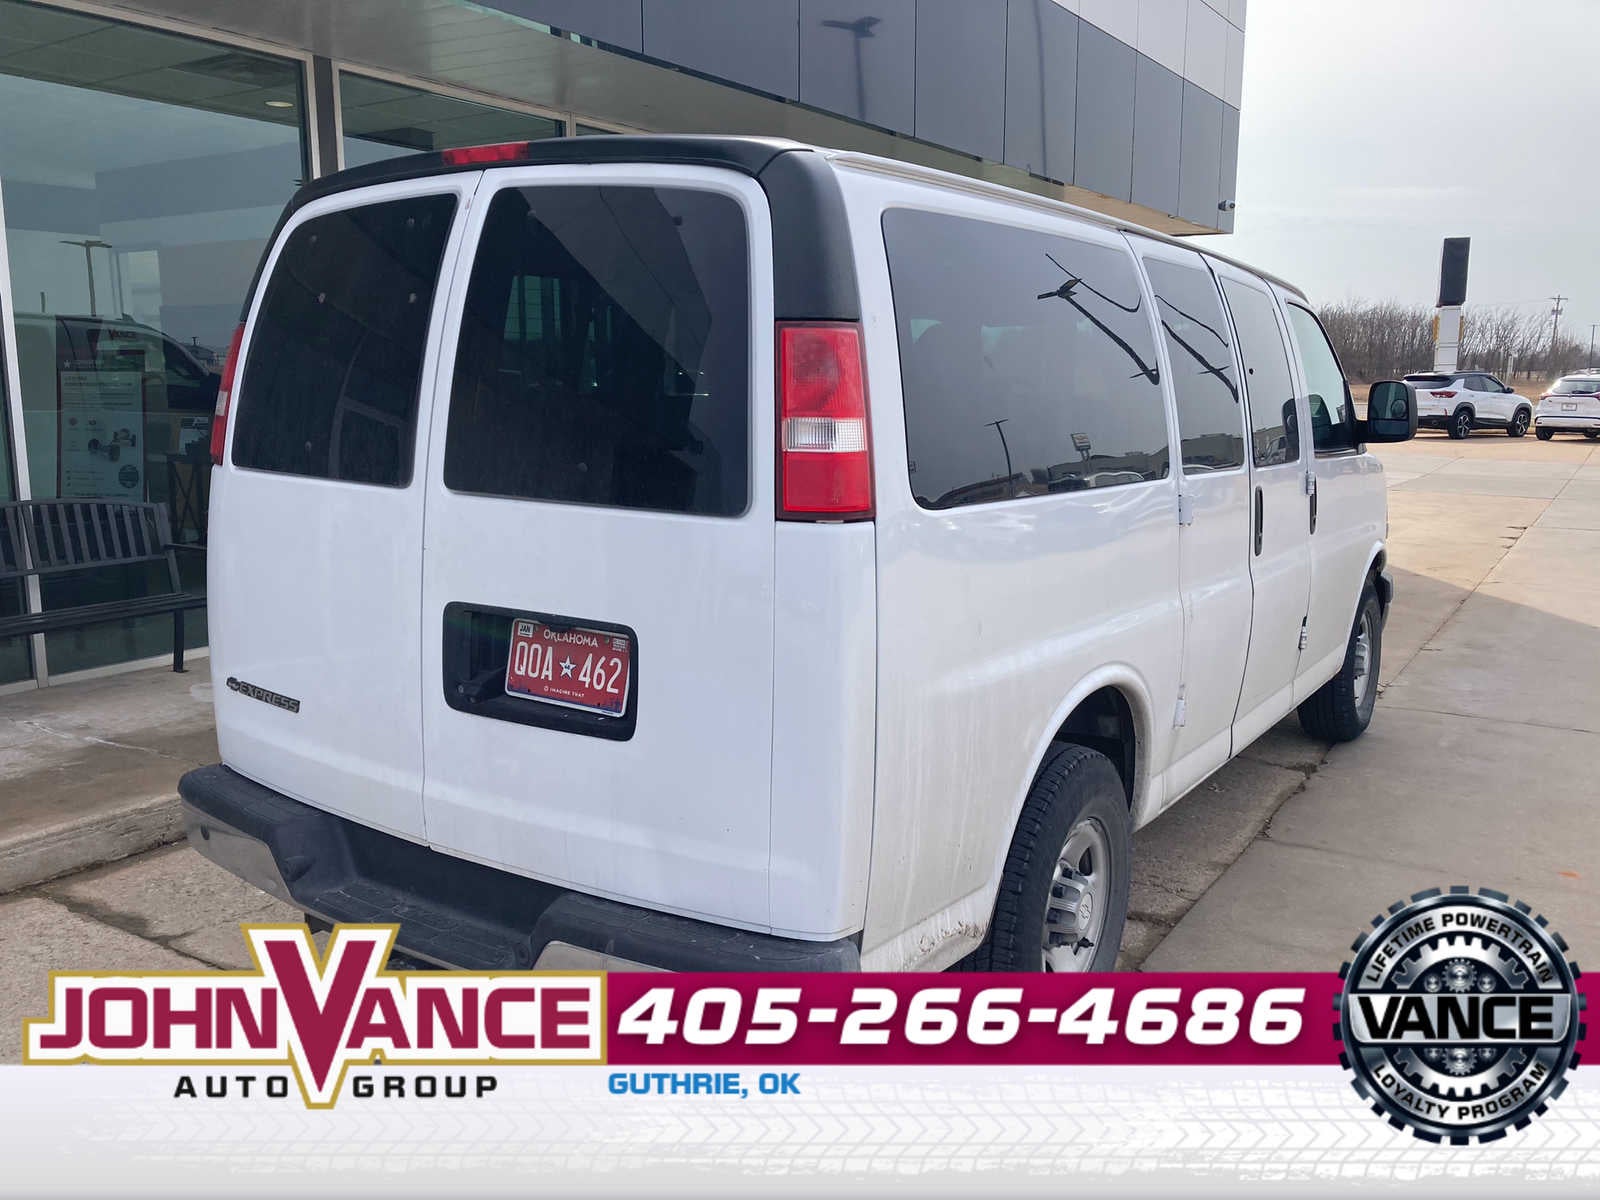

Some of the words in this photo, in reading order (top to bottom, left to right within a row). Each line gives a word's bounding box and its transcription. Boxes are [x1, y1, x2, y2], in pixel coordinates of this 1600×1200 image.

[543, 628, 599, 648] OKLAHOMA
[578, 652, 622, 694] 462
[239, 681, 301, 713] EXPRESS
